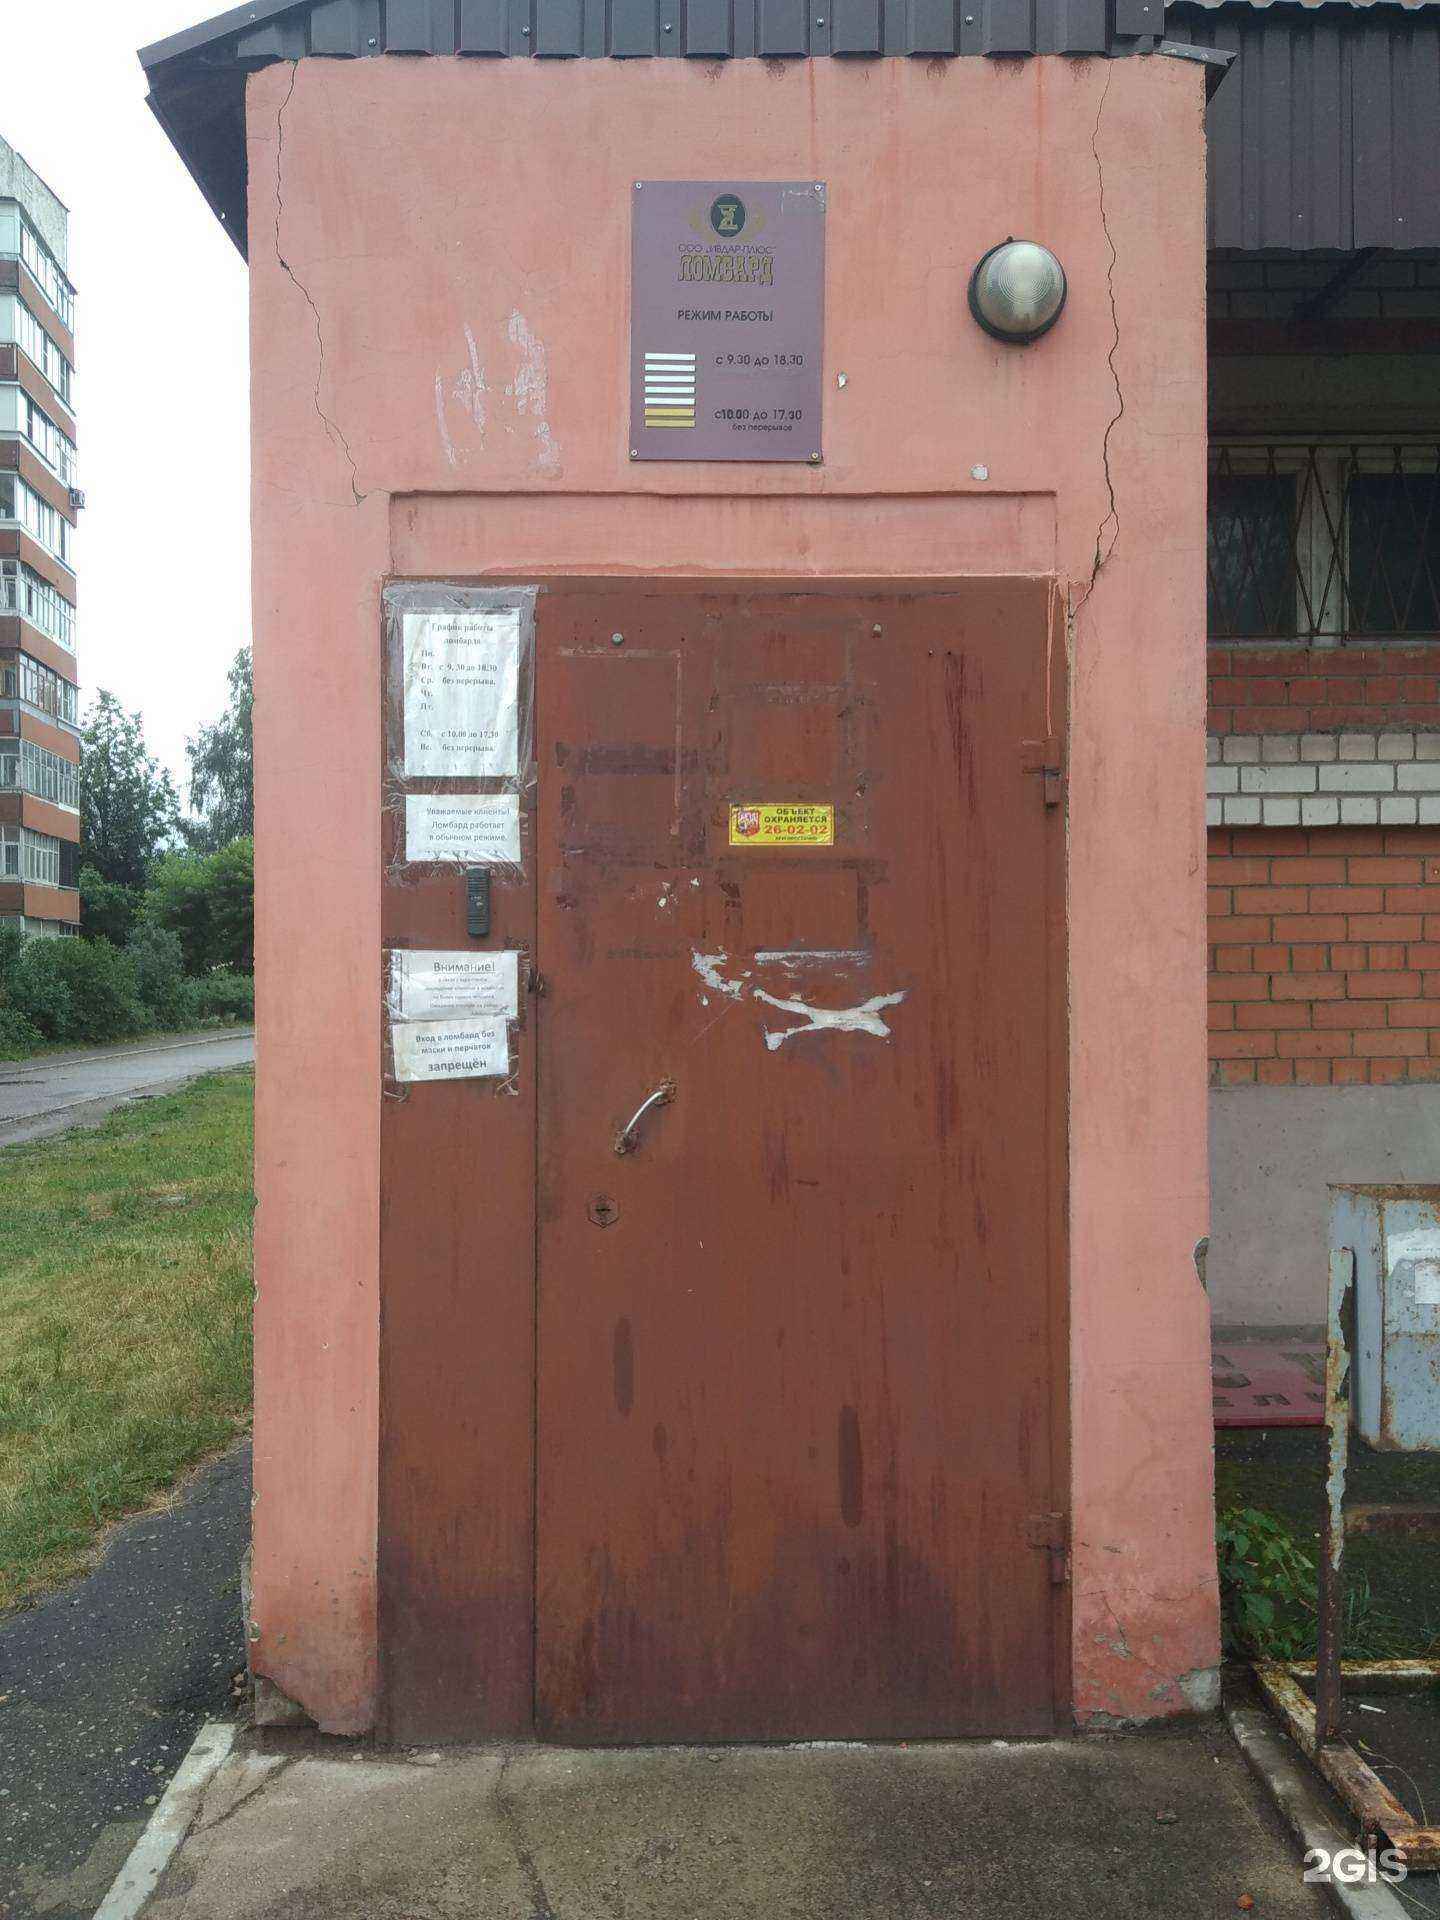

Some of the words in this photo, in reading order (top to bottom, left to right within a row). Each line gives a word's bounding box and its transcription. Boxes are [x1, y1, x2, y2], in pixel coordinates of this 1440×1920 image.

[678, 244, 702, 253] ООО
[678, 255, 774, 286] ЛОМБАРД
[677, 310, 721, 321] РЕЖИМ
[725, 310, 774, 322] РАБОТЫ
[715, 357, 723, 365] с
[727, 354, 750, 365] 9.30
[754, 356, 770, 367] до
[774, 354, 803, 366] 18.30
[753, 411, 768, 421] до
[773, 410, 802, 421] 17.30
[732, 423, 746, 431] без
[432, 623, 462, 633] График
[464, 623, 494, 632] работы
[443, 637, 481, 646] ломбарда
[442, 677, 454, 685] без
[427, 808, 472, 816] Уважаемые
[764, 815, 828, 823] ОХРАНЯЕТСЯ
[432, 821, 468, 830] Ломбард
[469, 822, 505, 830] работает
[764, 824, 828, 834] 26-02-02
[433, 962, 496, 972] Внимание!
[415, 1035, 435, 1043] Вход
[444, 1032, 480, 1041] ломбард
[481, 1030, 495, 1038] без
[421, 1046, 446, 1054] маски
[454, 1044, 491, 1053] перчаток
